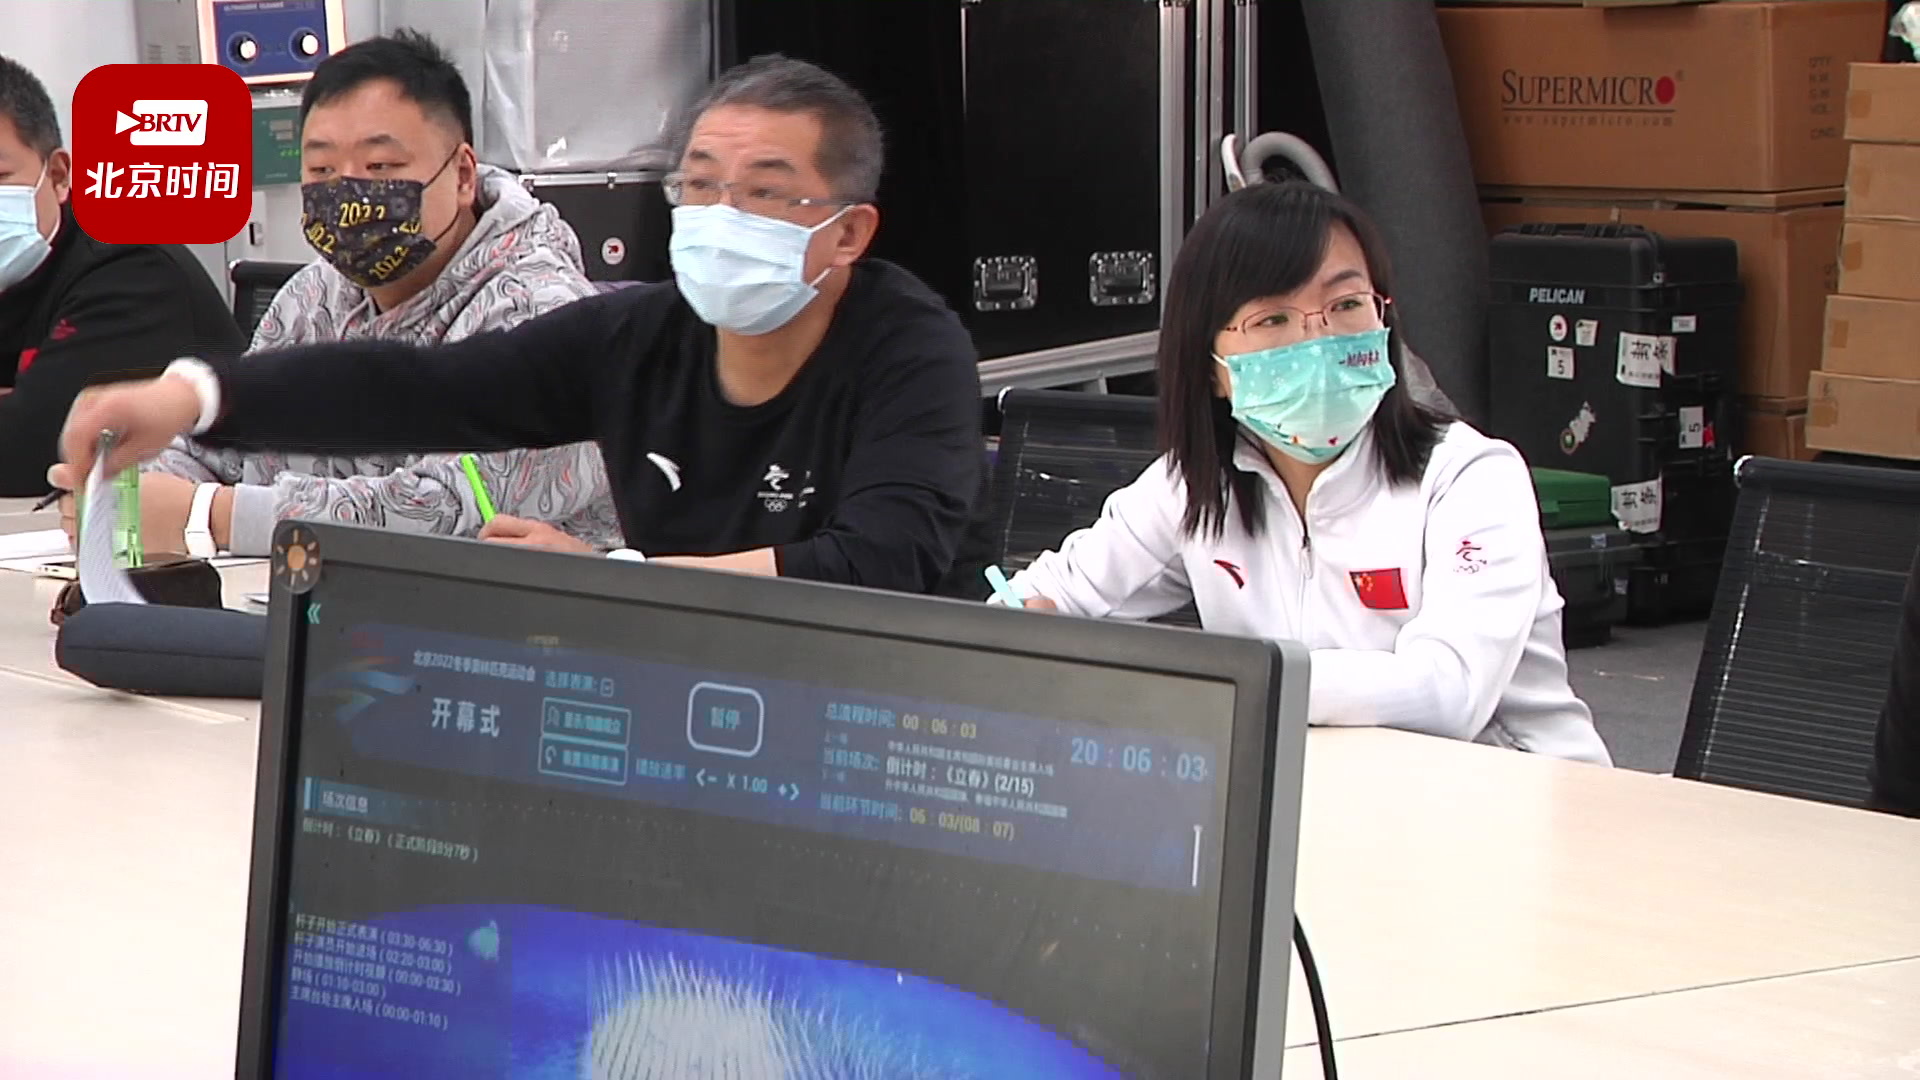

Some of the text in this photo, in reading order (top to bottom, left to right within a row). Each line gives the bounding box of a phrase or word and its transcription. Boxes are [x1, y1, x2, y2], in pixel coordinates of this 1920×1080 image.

[1529, 287, 1585, 304] PELICAN
[1557, 359, 1566, 376] 5
[432, 697, 501, 738] 开幕式
[711, 707, 741, 730] 暂停
[323, 791, 368, 813] 场次信息
